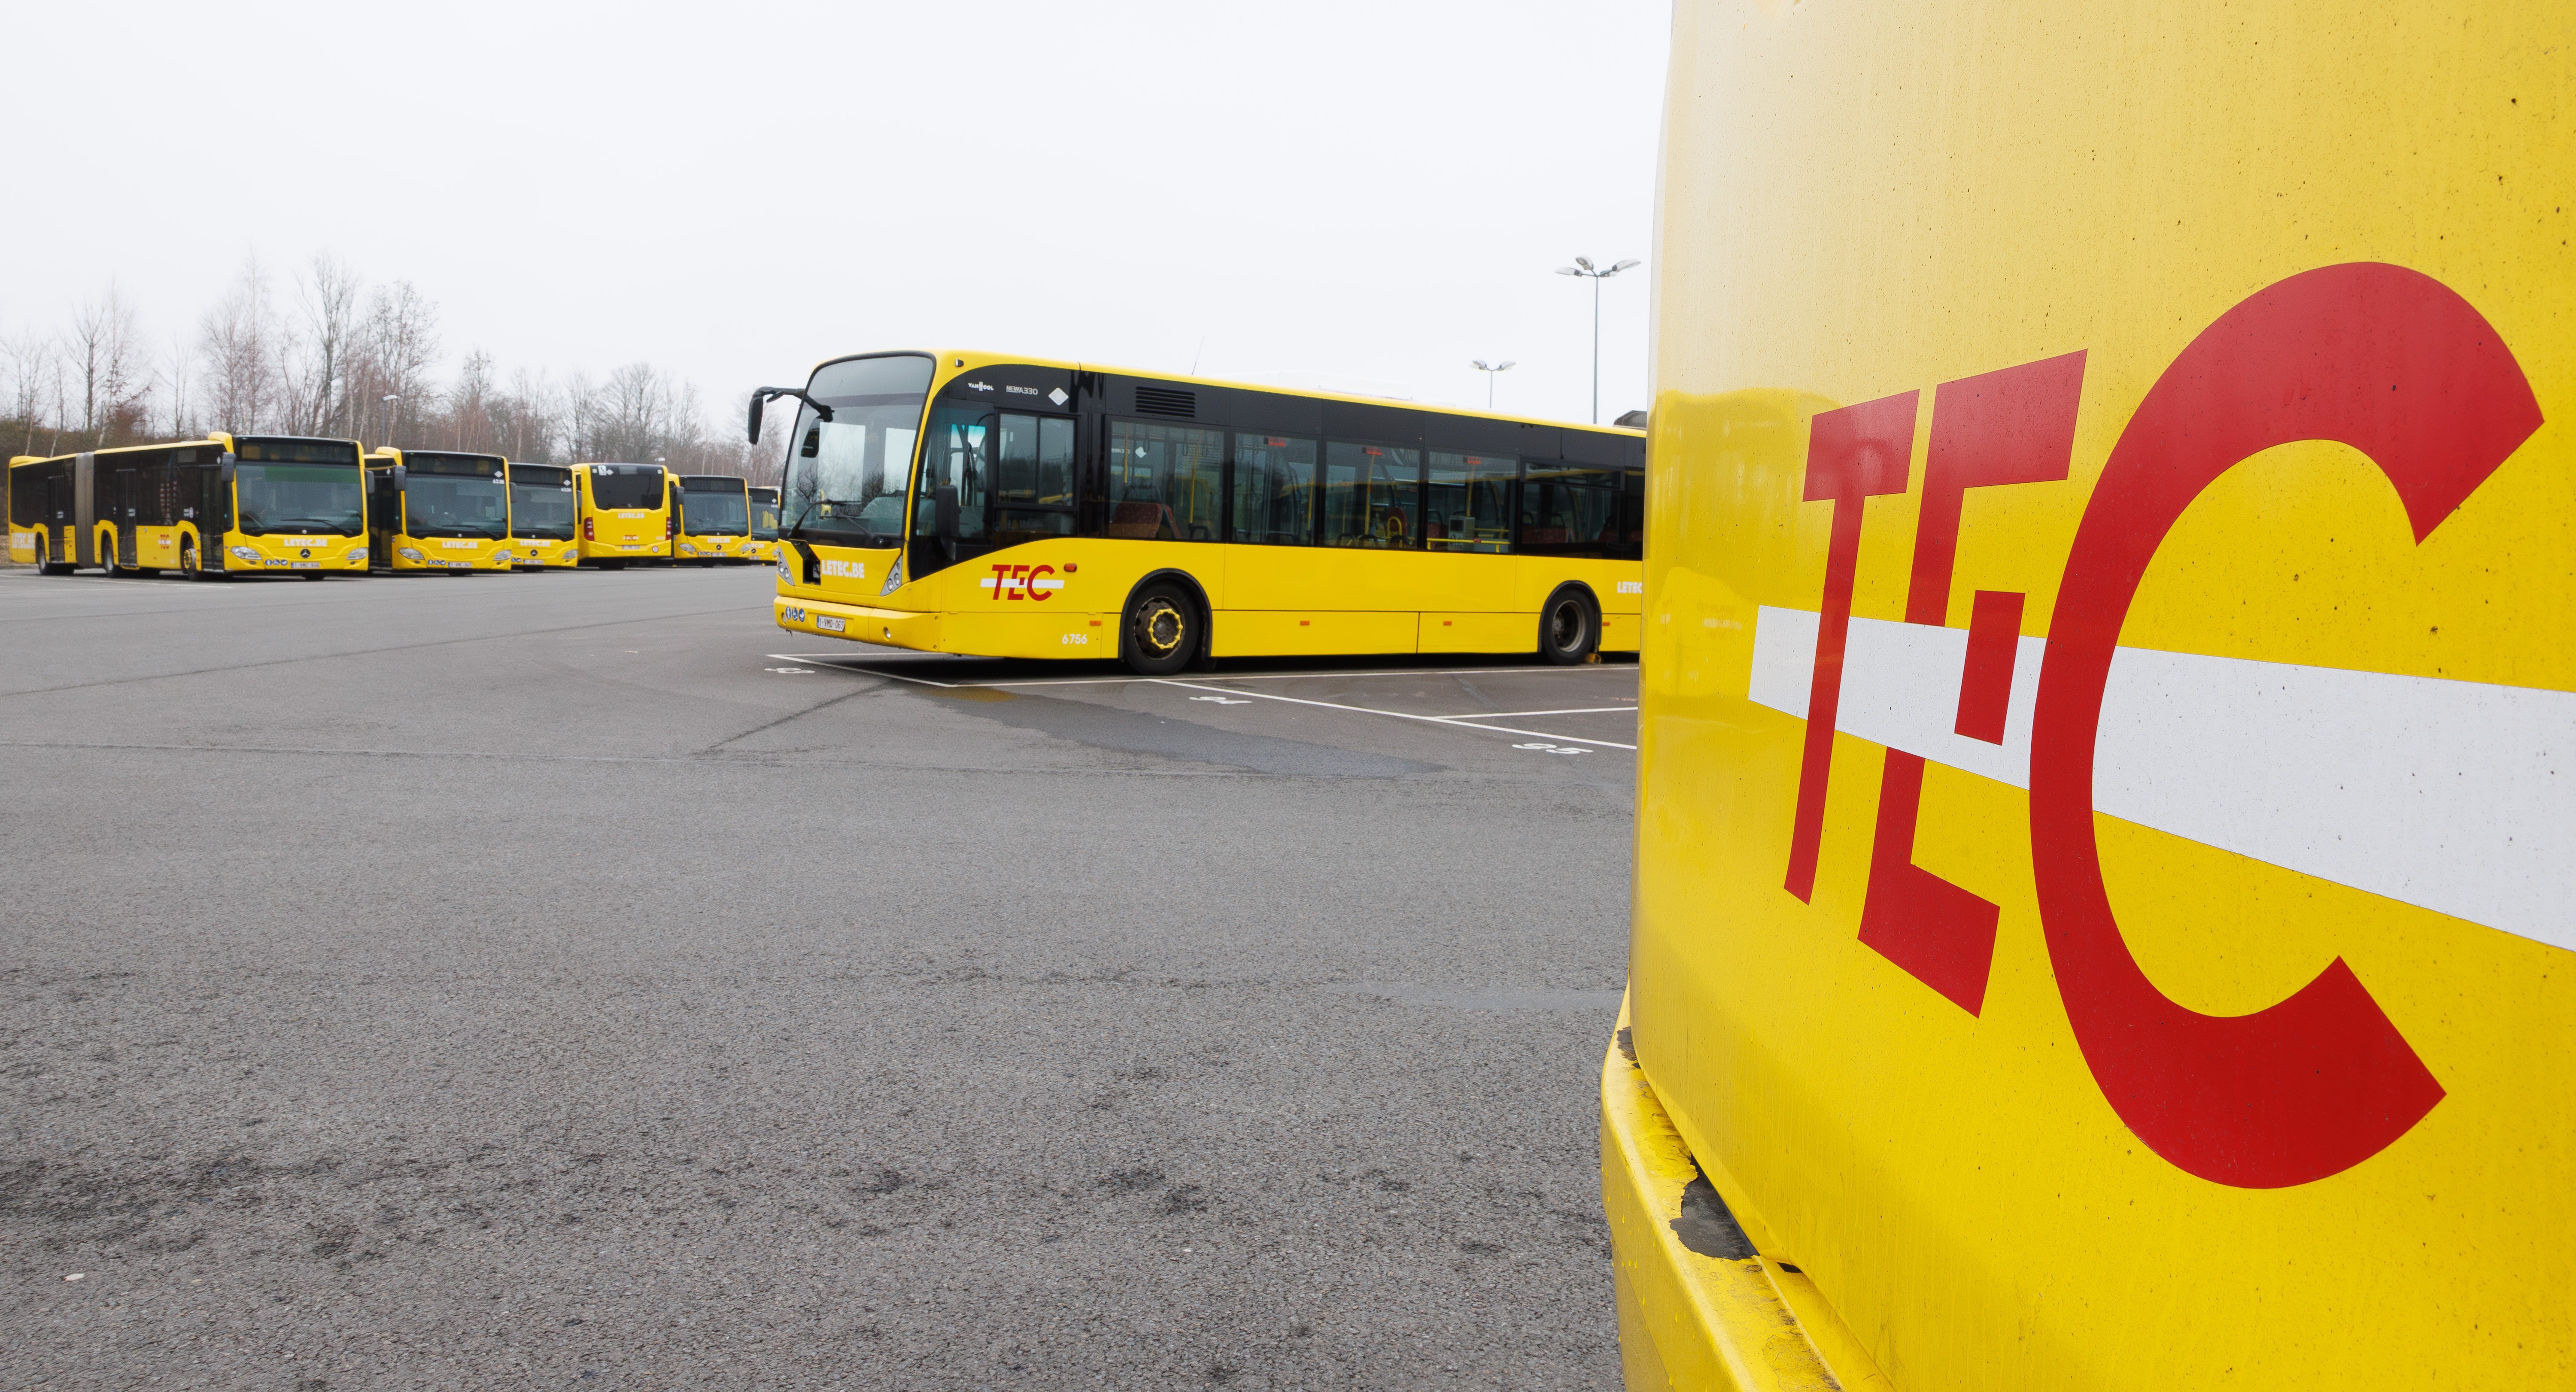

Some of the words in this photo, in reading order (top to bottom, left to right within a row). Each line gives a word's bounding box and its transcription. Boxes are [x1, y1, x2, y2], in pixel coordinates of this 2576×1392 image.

[822, 559, 865, 579] LETEC.BE
[992, 564, 1055, 601] TEC
[1617, 581, 1642, 594] LETEC
[1062, 634, 1088, 645] 6756
[1784, 261, 2545, 1190] TEC
[1512, 743, 1594, 754] 95
